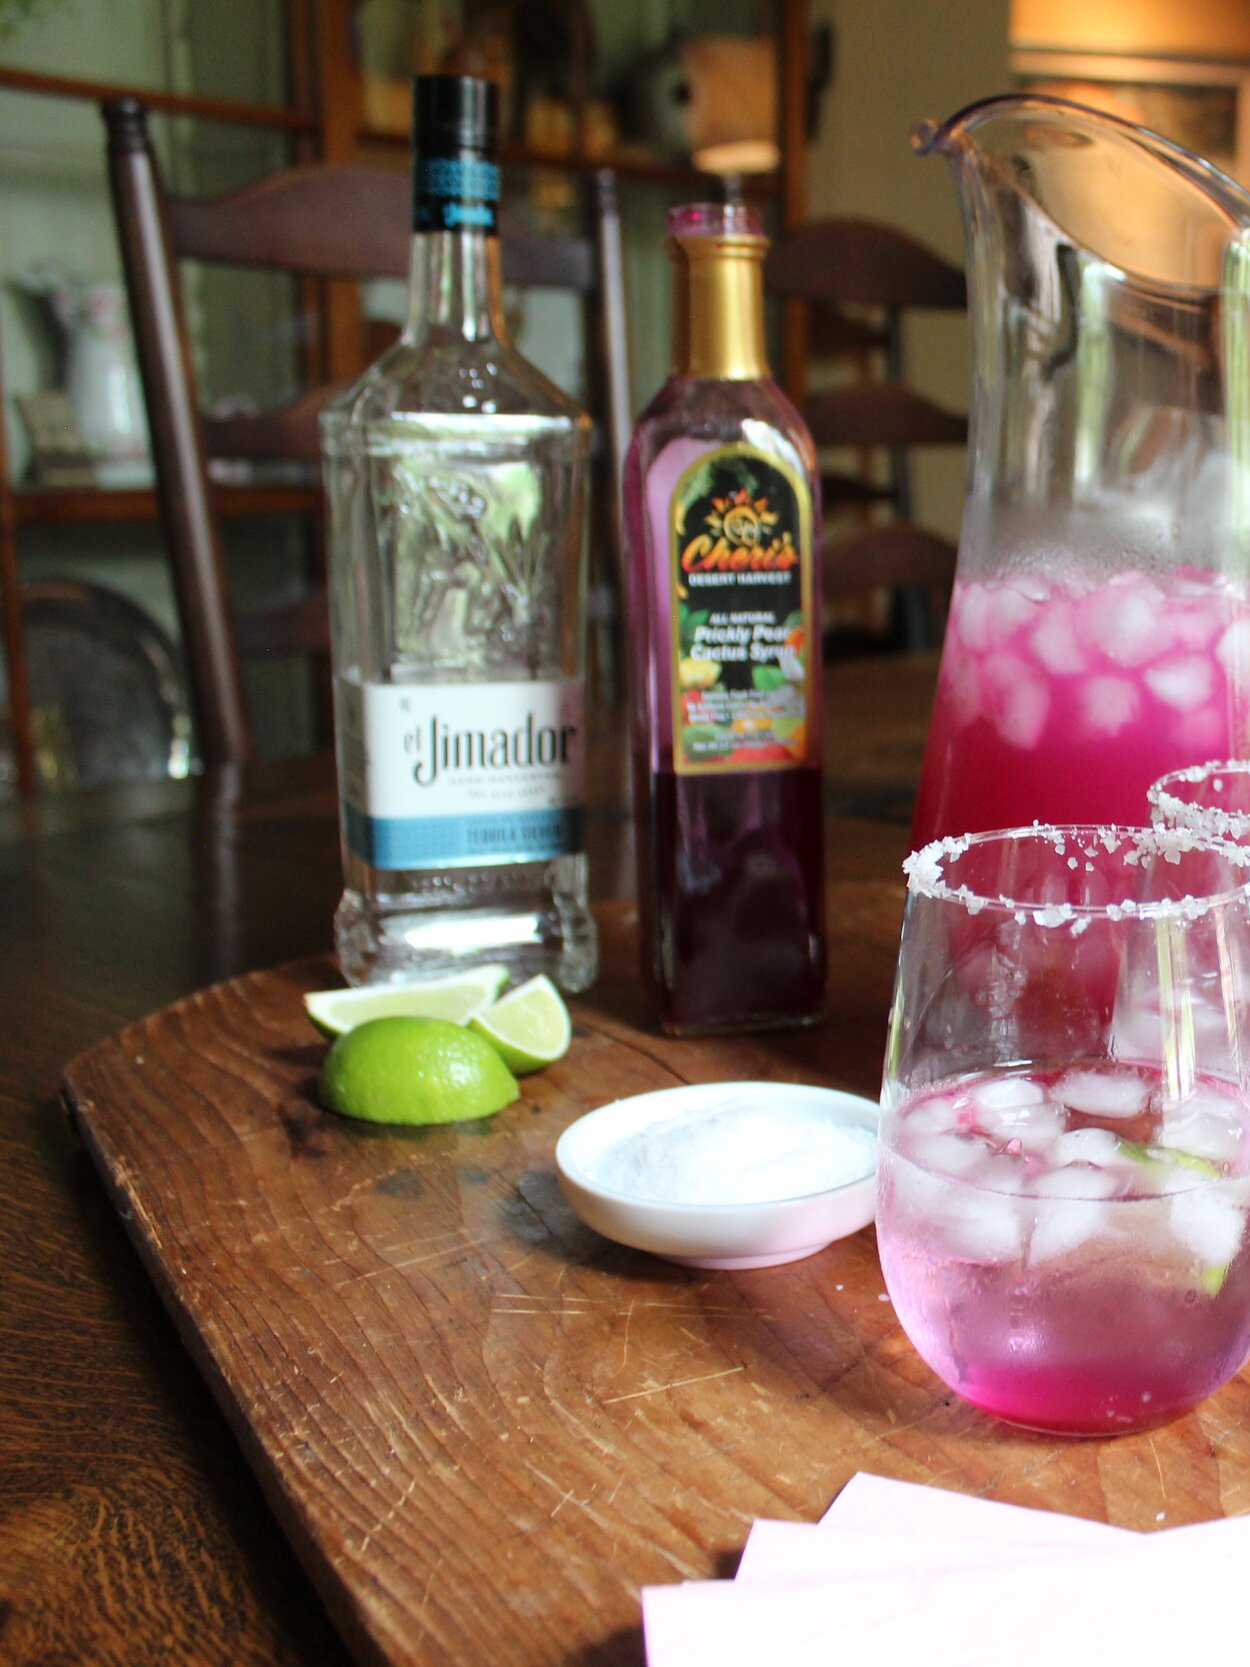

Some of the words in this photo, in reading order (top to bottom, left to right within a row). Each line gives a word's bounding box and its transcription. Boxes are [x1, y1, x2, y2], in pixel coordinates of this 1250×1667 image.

[688, 571, 736, 587] DESERT
[737, 570, 791, 586] HARVEST
[694, 624, 752, 646] Prickly
[690, 643, 747, 662] Cactus
[413, 712, 577, 787] Jimador
